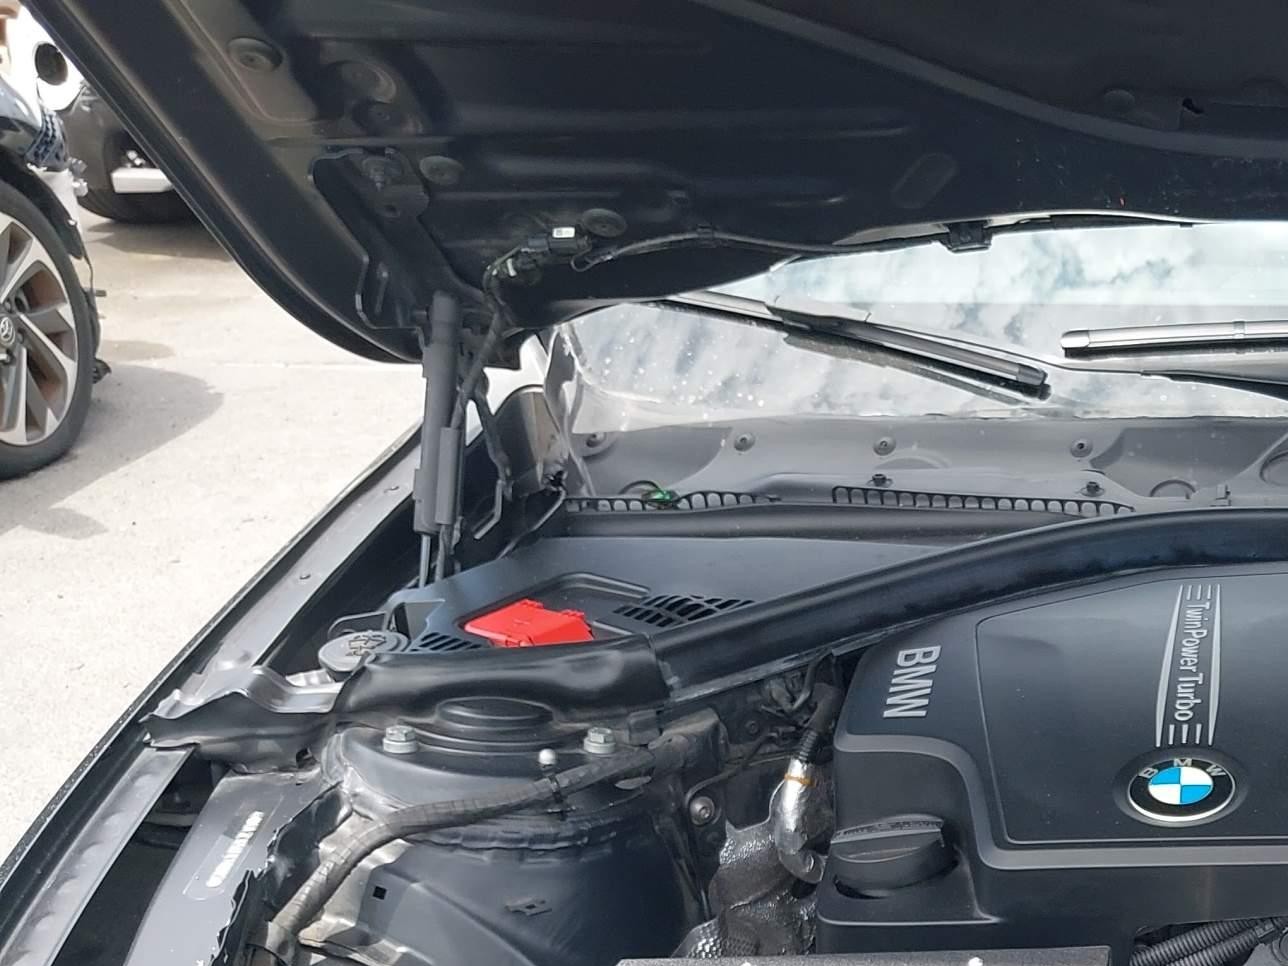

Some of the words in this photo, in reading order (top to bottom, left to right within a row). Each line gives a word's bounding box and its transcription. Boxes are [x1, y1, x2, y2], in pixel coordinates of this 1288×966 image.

[1179, 602, 1210, 672] TwinPower
[883, 645, 942, 718] BMW
[1174, 672, 1204, 721] Turbo
[1138, 758, 1226, 779] BMW
